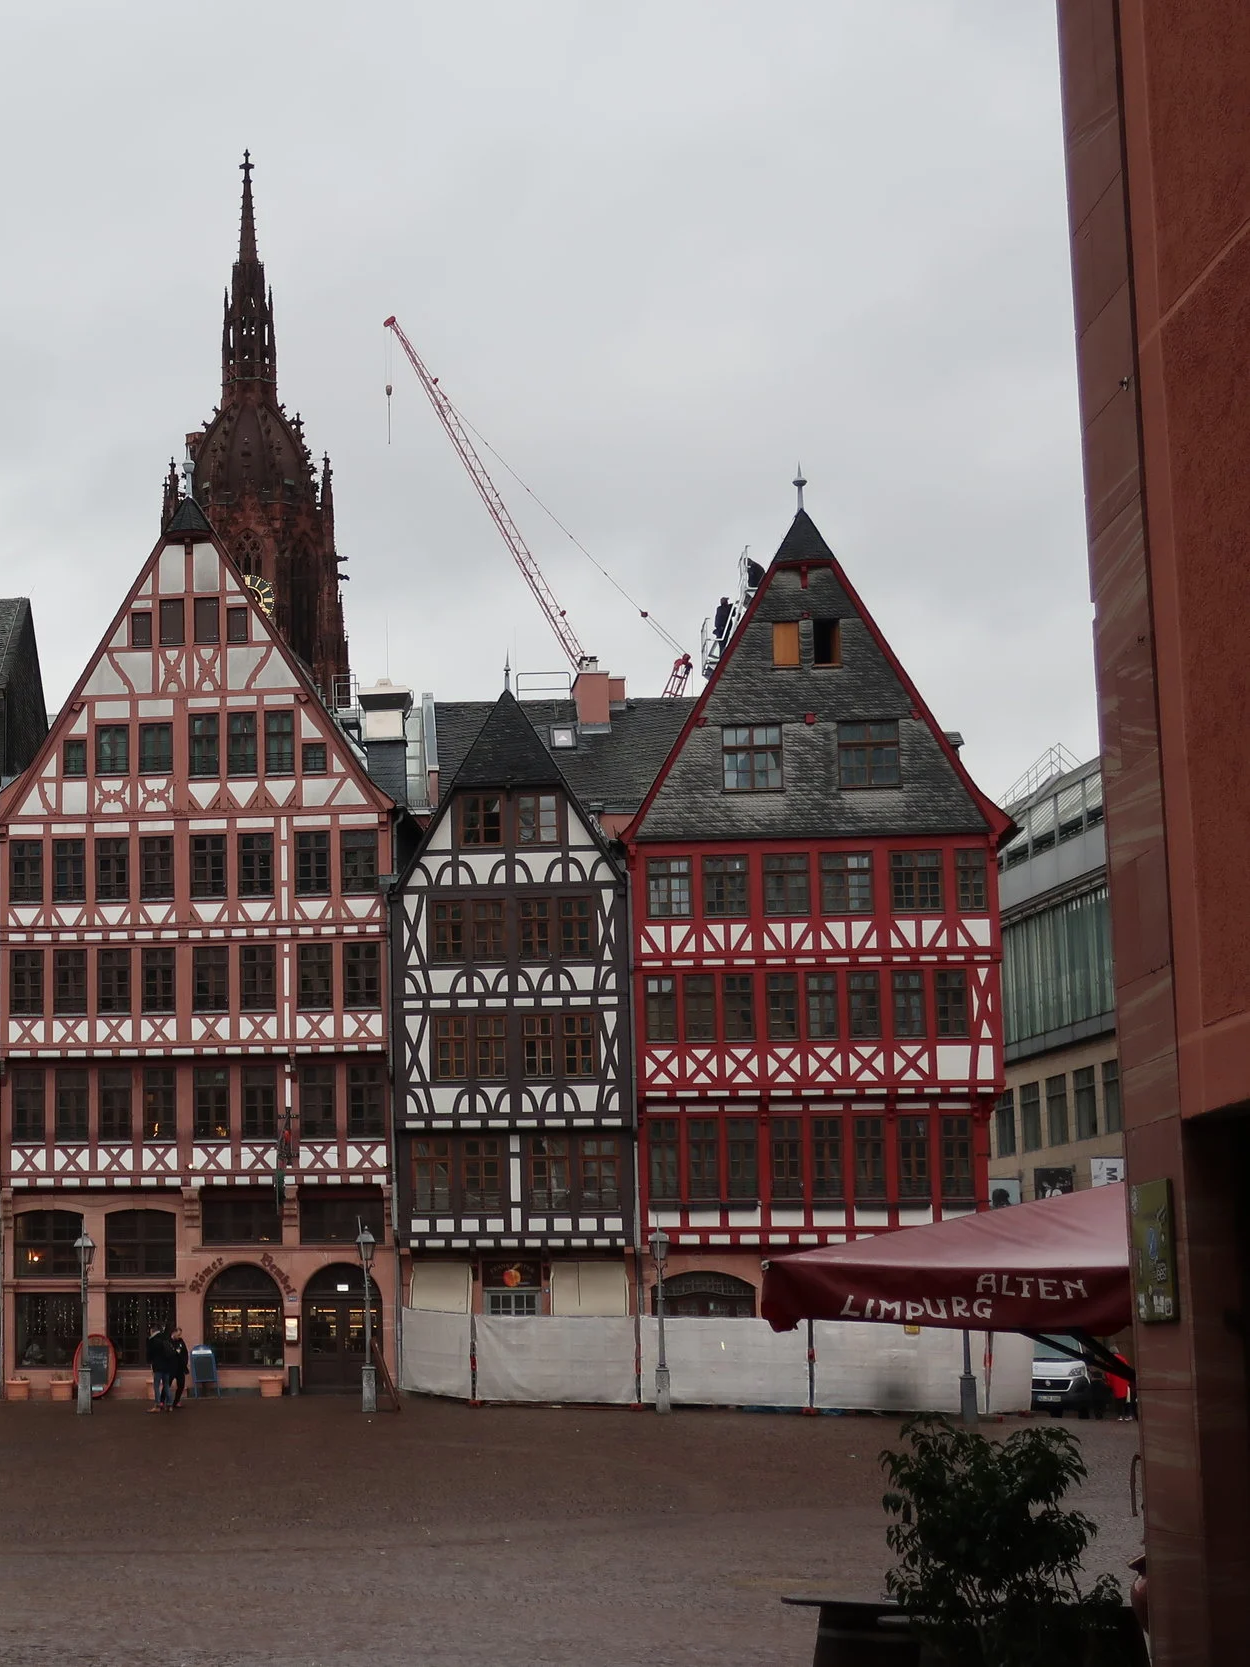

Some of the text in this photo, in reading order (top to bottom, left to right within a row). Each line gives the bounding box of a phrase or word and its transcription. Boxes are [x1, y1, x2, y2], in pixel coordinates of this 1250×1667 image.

[189, 1257, 224, 1294] Römer
[260, 1252, 297, 1295] Bembel
[976, 1273, 1089, 1300] ALTEN
[840, 1295, 993, 1320] LIMPURG
